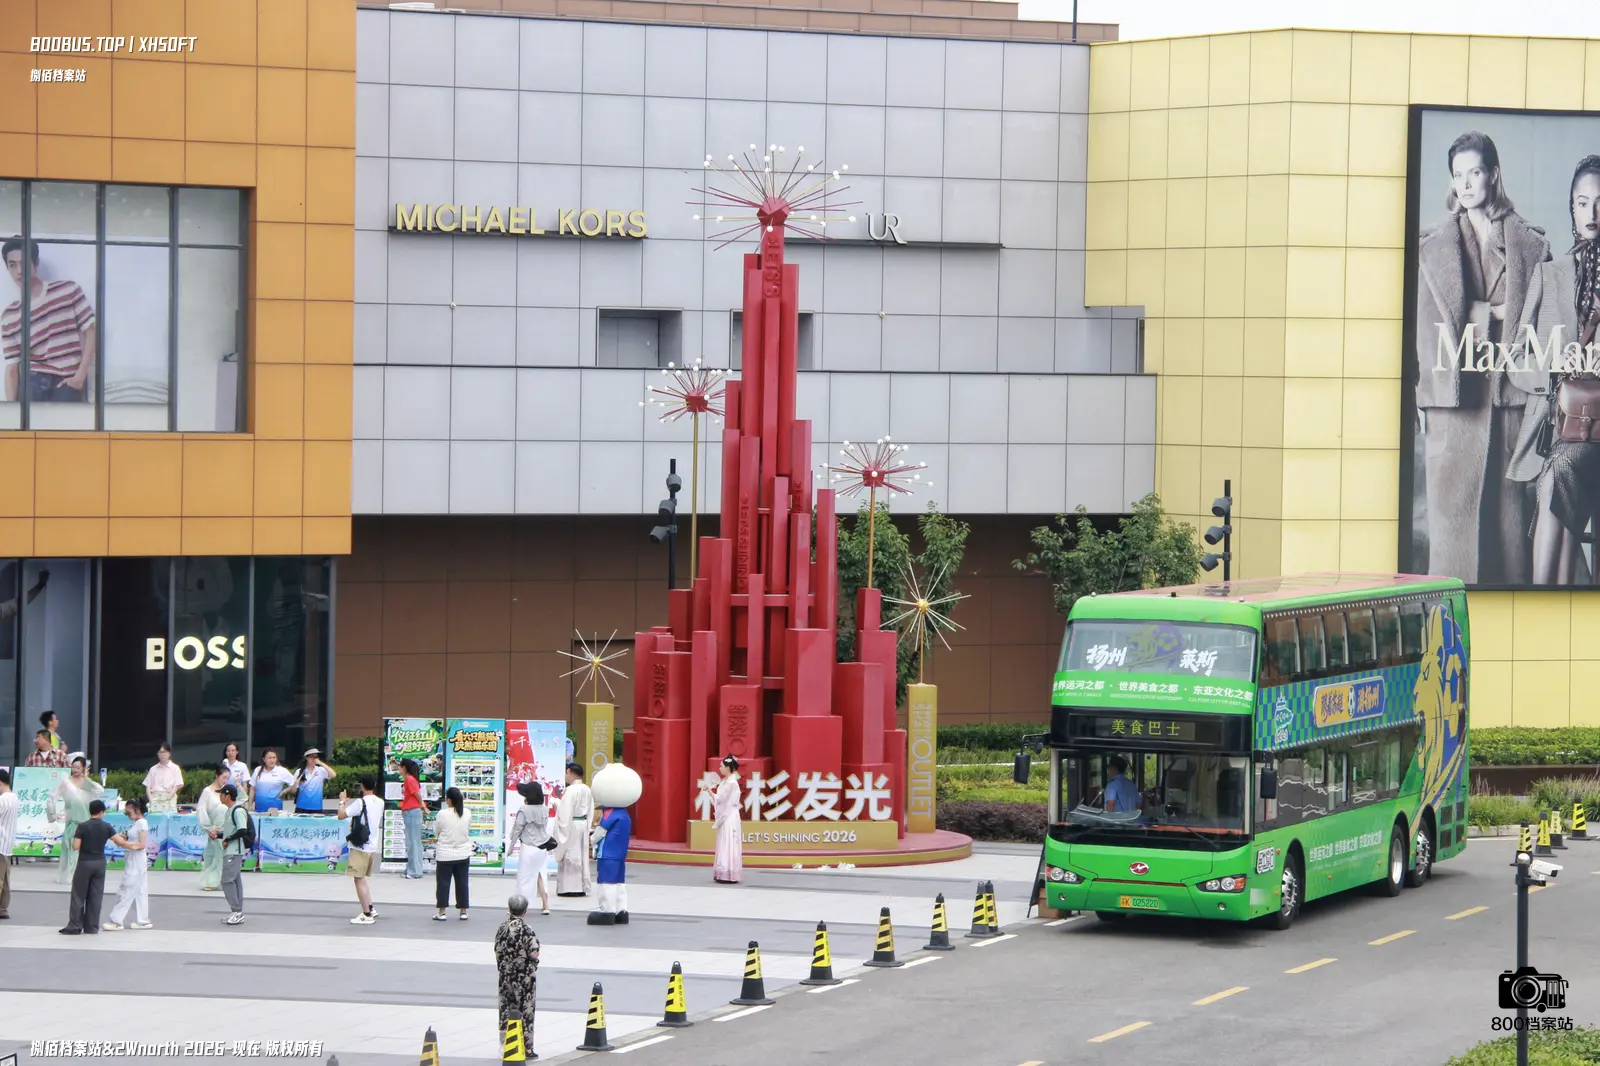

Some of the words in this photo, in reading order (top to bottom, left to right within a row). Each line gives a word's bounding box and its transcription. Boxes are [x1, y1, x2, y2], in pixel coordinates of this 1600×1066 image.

[395, 203, 546, 235] MICHAEL
[558, 208, 649, 239] KORS
[865, 212, 908, 245] UR
[145, 635, 246, 670] BOSS
[1085, 643, 1128, 672] 扬州
[1179, 648, 1218, 677] 莱斯
[1119, 681, 1178, 694] 世界美食之都
[1111, 719, 1181, 736] 美食巴士
[773, 832, 820, 844] SHINING
[822, 830, 857, 844] 2026
